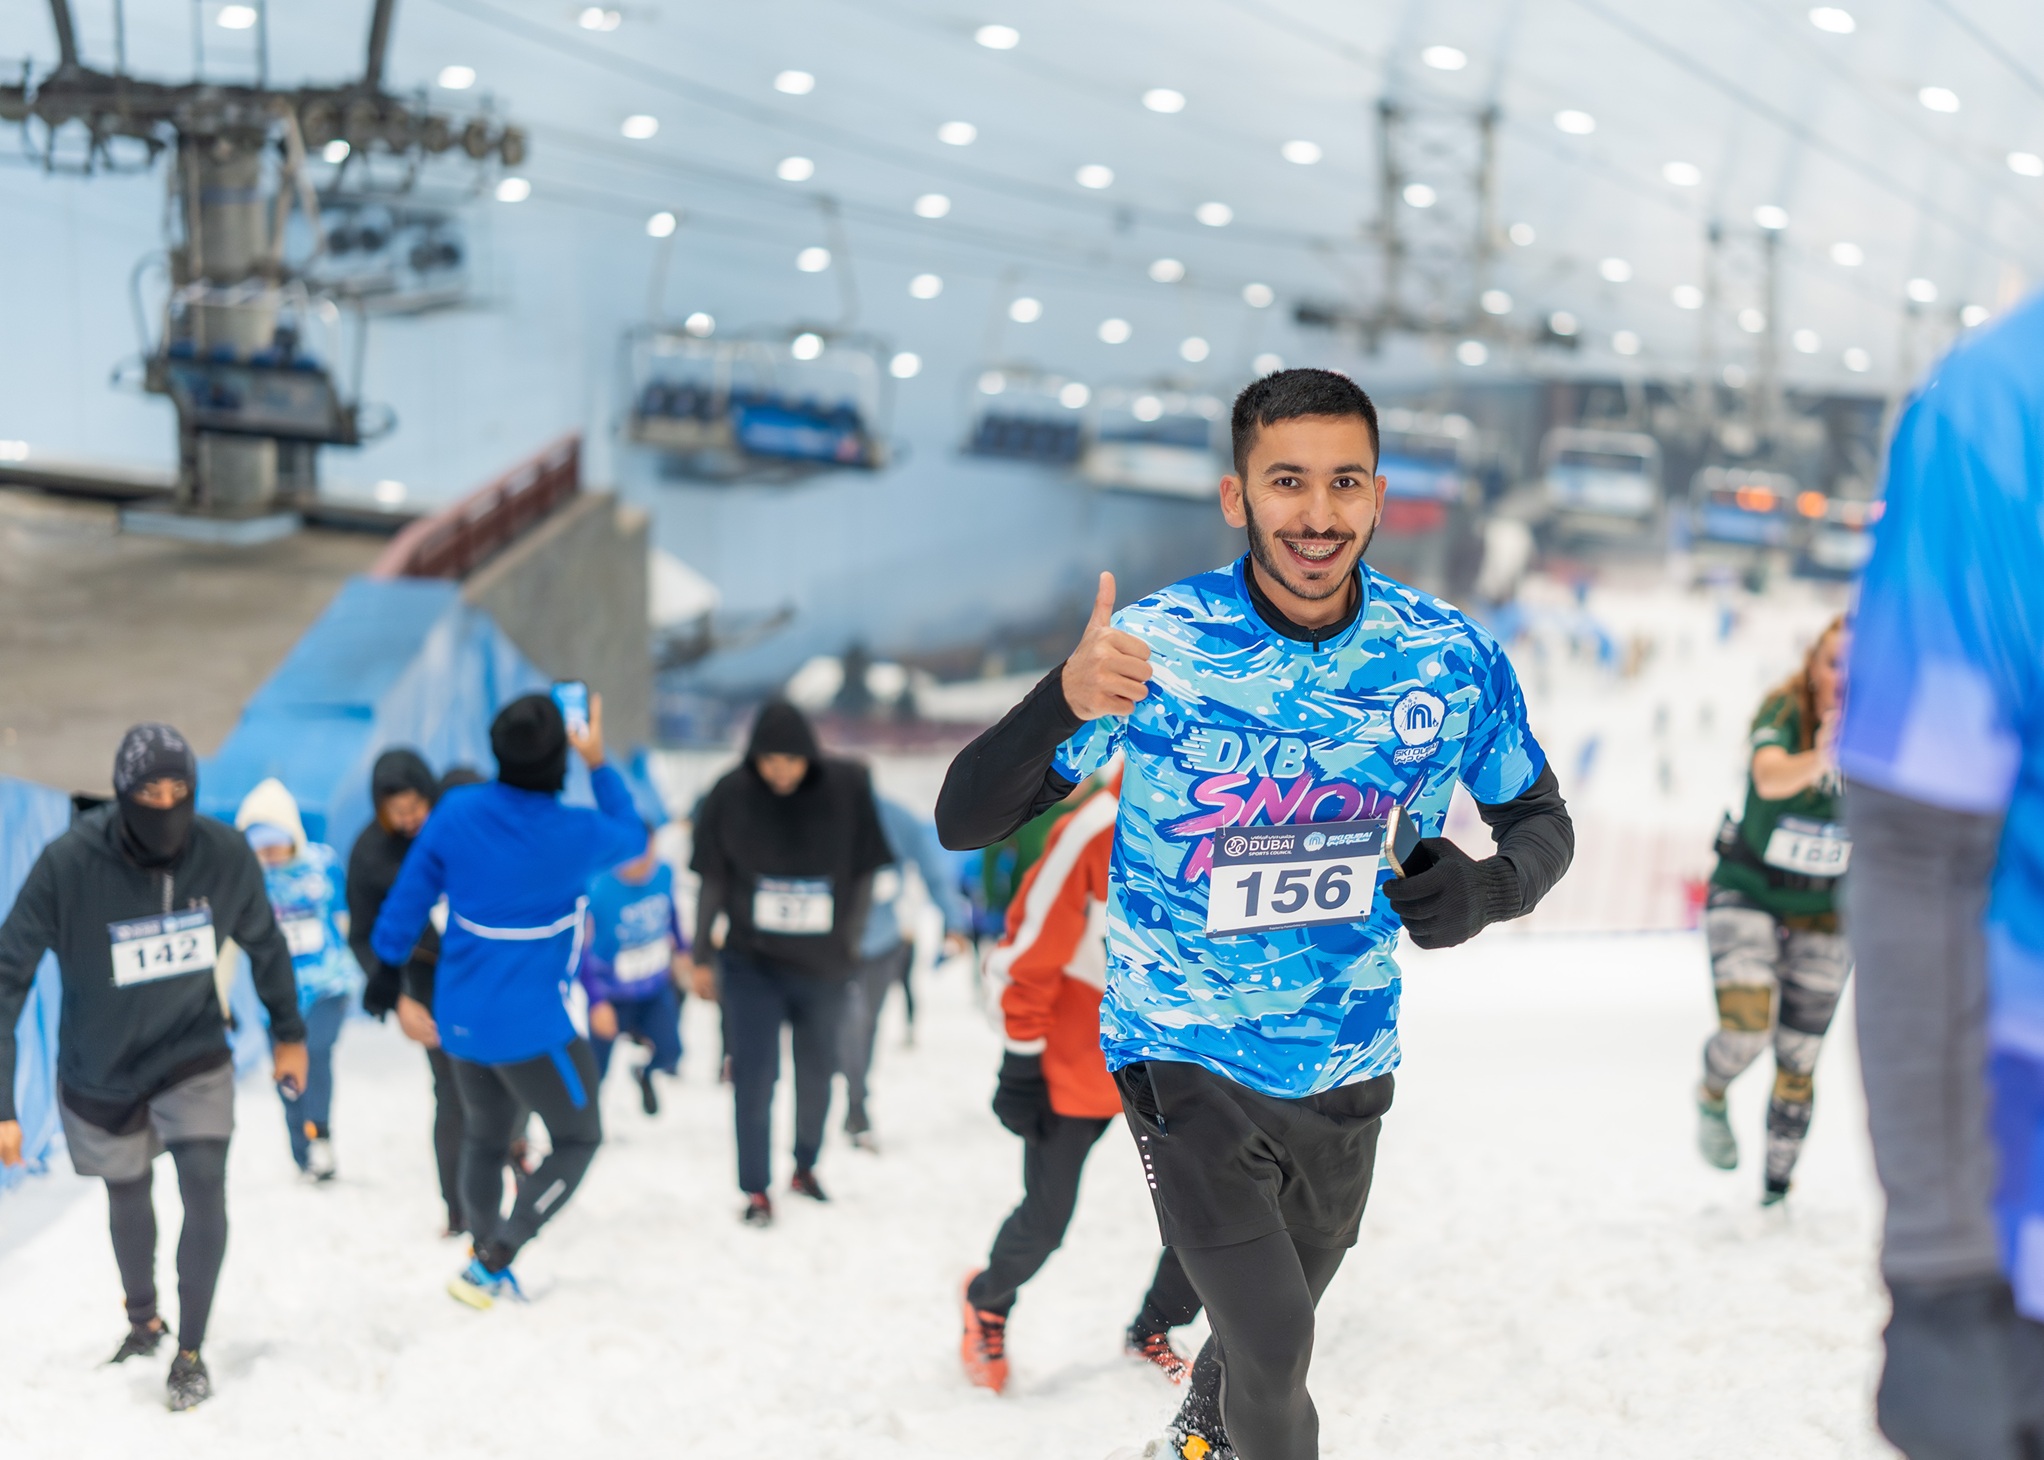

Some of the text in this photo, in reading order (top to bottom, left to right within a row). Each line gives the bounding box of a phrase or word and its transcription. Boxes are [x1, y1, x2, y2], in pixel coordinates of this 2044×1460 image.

[1183, 727, 1308, 779] DXB
[1395, 748, 1411, 757] SKI
[1249, 838, 1295, 851] DUBAI
[1345, 831, 1373, 840] DUBAI
[1236, 865, 1353, 918] 156
[132, 932, 199, 968] 142
